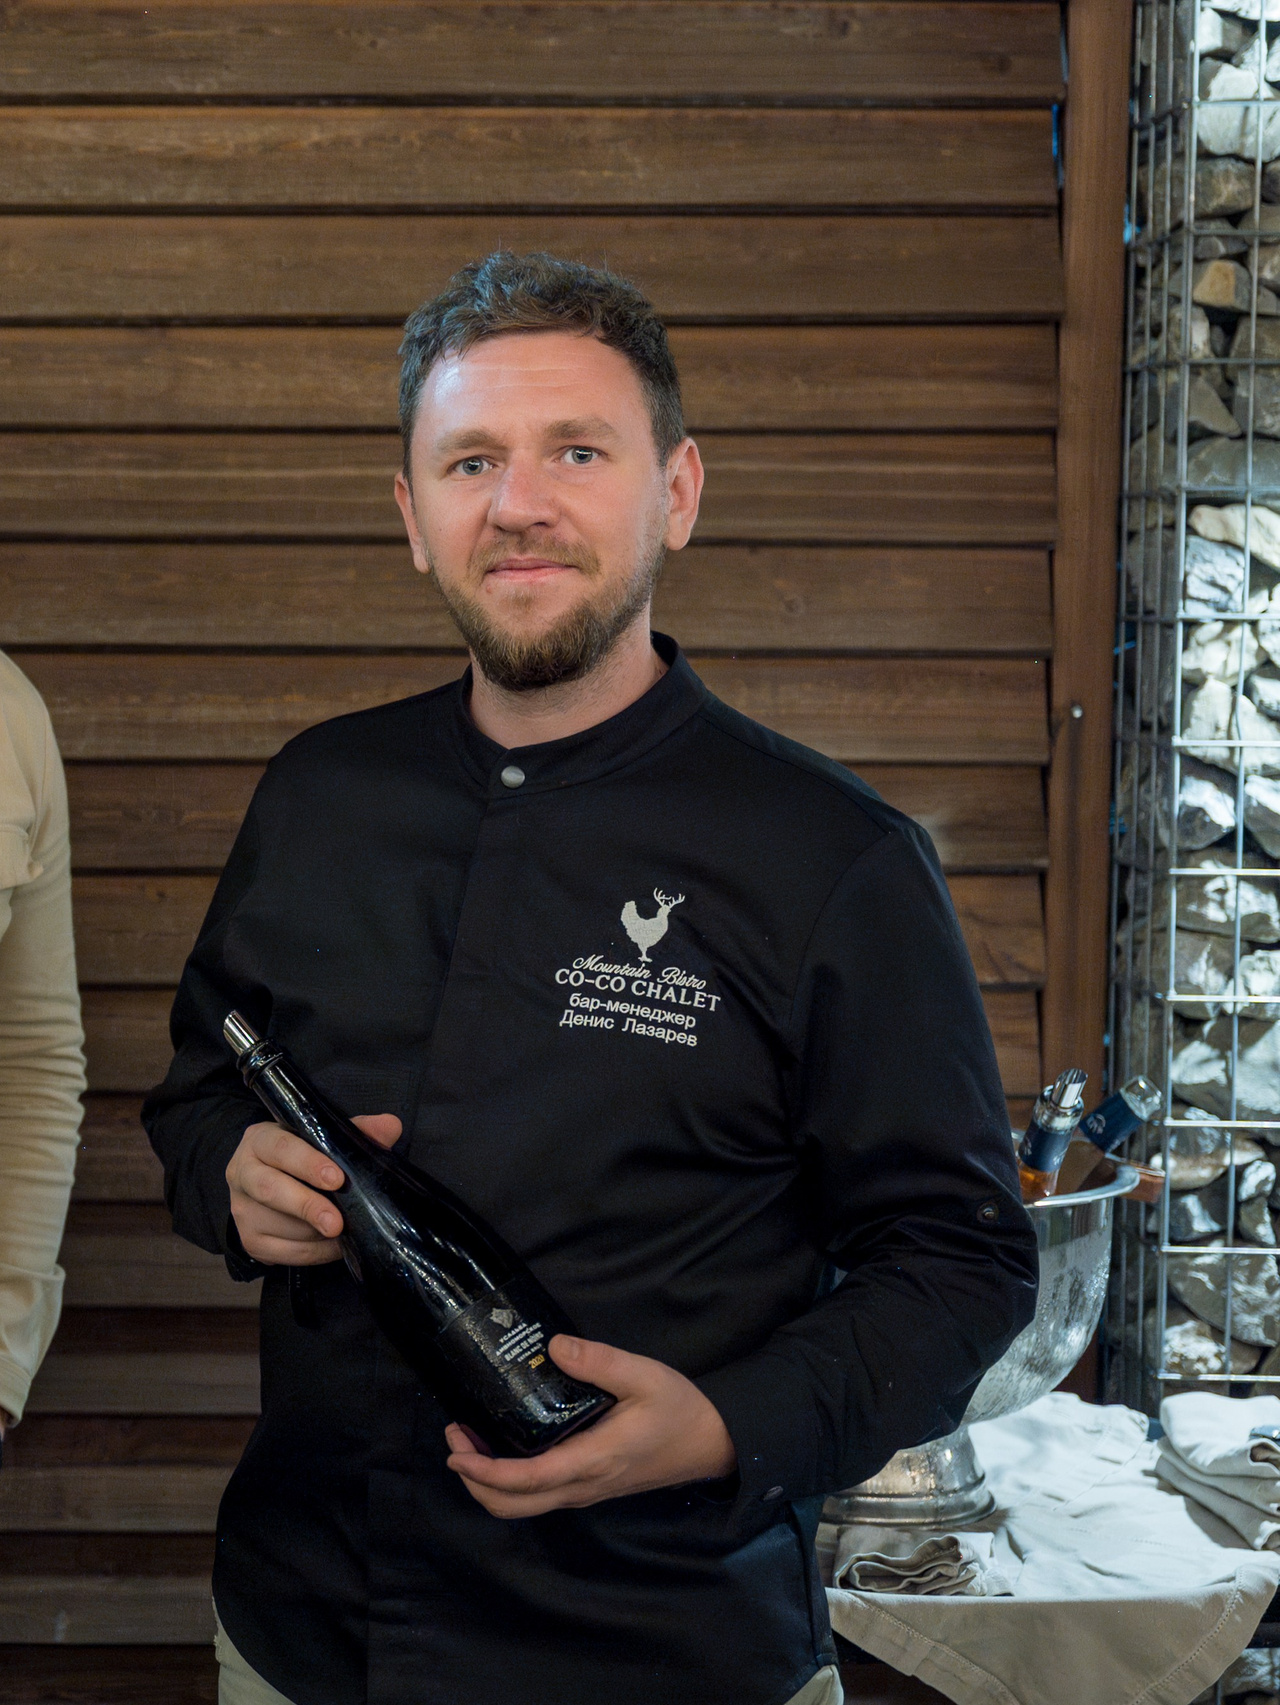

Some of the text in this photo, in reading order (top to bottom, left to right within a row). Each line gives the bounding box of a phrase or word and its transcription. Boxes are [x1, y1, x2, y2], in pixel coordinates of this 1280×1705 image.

[555, 968, 721, 1012] CO-CO CHALET
[572, 954, 707, 990] Mountain Bistro
[559, 1009, 698, 1047] Денис Лазарев
[569, 992, 696, 1030] бар-менеджер
[504, 1345, 523, 1362] BLANC
[520, 1340, 530, 1350] DE
[528, 1354, 545, 1369] 2020
